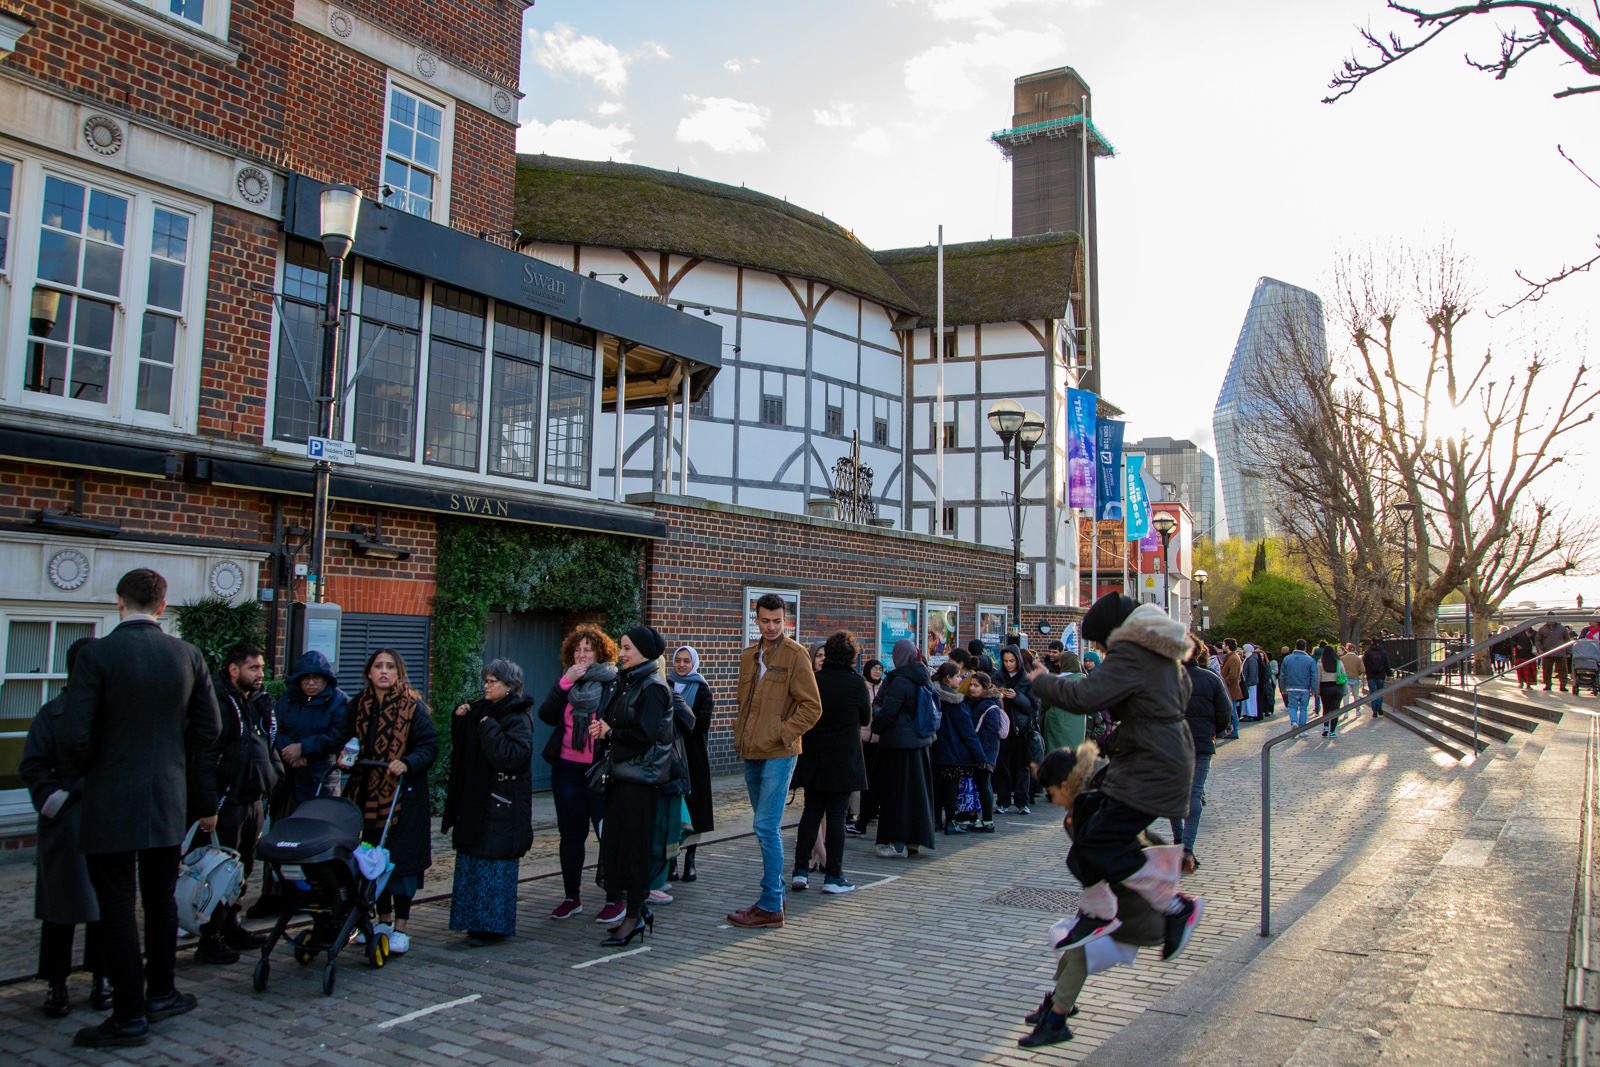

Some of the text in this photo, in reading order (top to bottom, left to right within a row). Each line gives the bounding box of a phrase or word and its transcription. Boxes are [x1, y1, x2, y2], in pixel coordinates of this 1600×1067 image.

[523, 262, 566, 295] Swan
[311, 440, 322, 455] P
[326, 440, 342, 448] Permit
[324, 447, 343, 455] holders
[450, 493, 509, 517] SWAN
[886, 621, 908, 630] SUMMER
